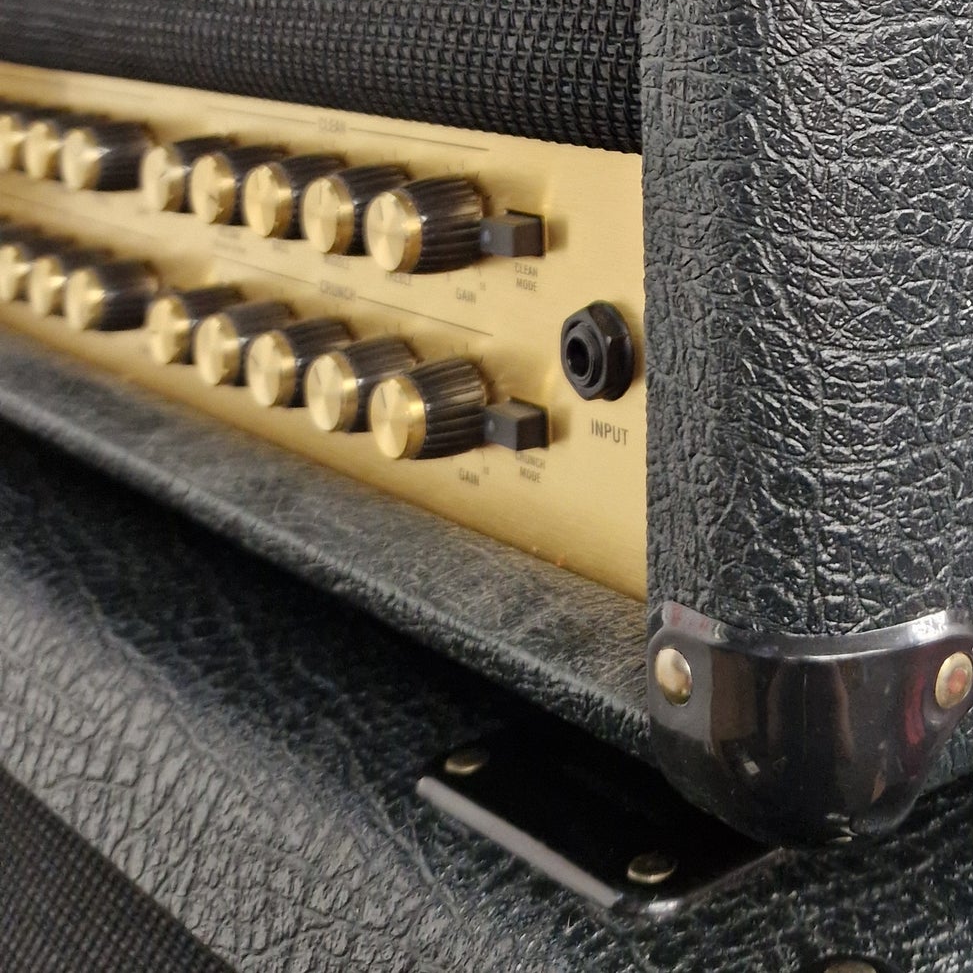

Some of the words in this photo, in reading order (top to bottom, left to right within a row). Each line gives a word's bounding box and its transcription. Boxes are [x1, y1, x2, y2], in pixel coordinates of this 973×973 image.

[514, 262, 538, 277] CLEAN
[516, 278, 538, 292] MODE
[591, 418, 629, 446] INPUT
[459, 467, 480, 486] GAIN
[519, 466, 541, 483] MODE
